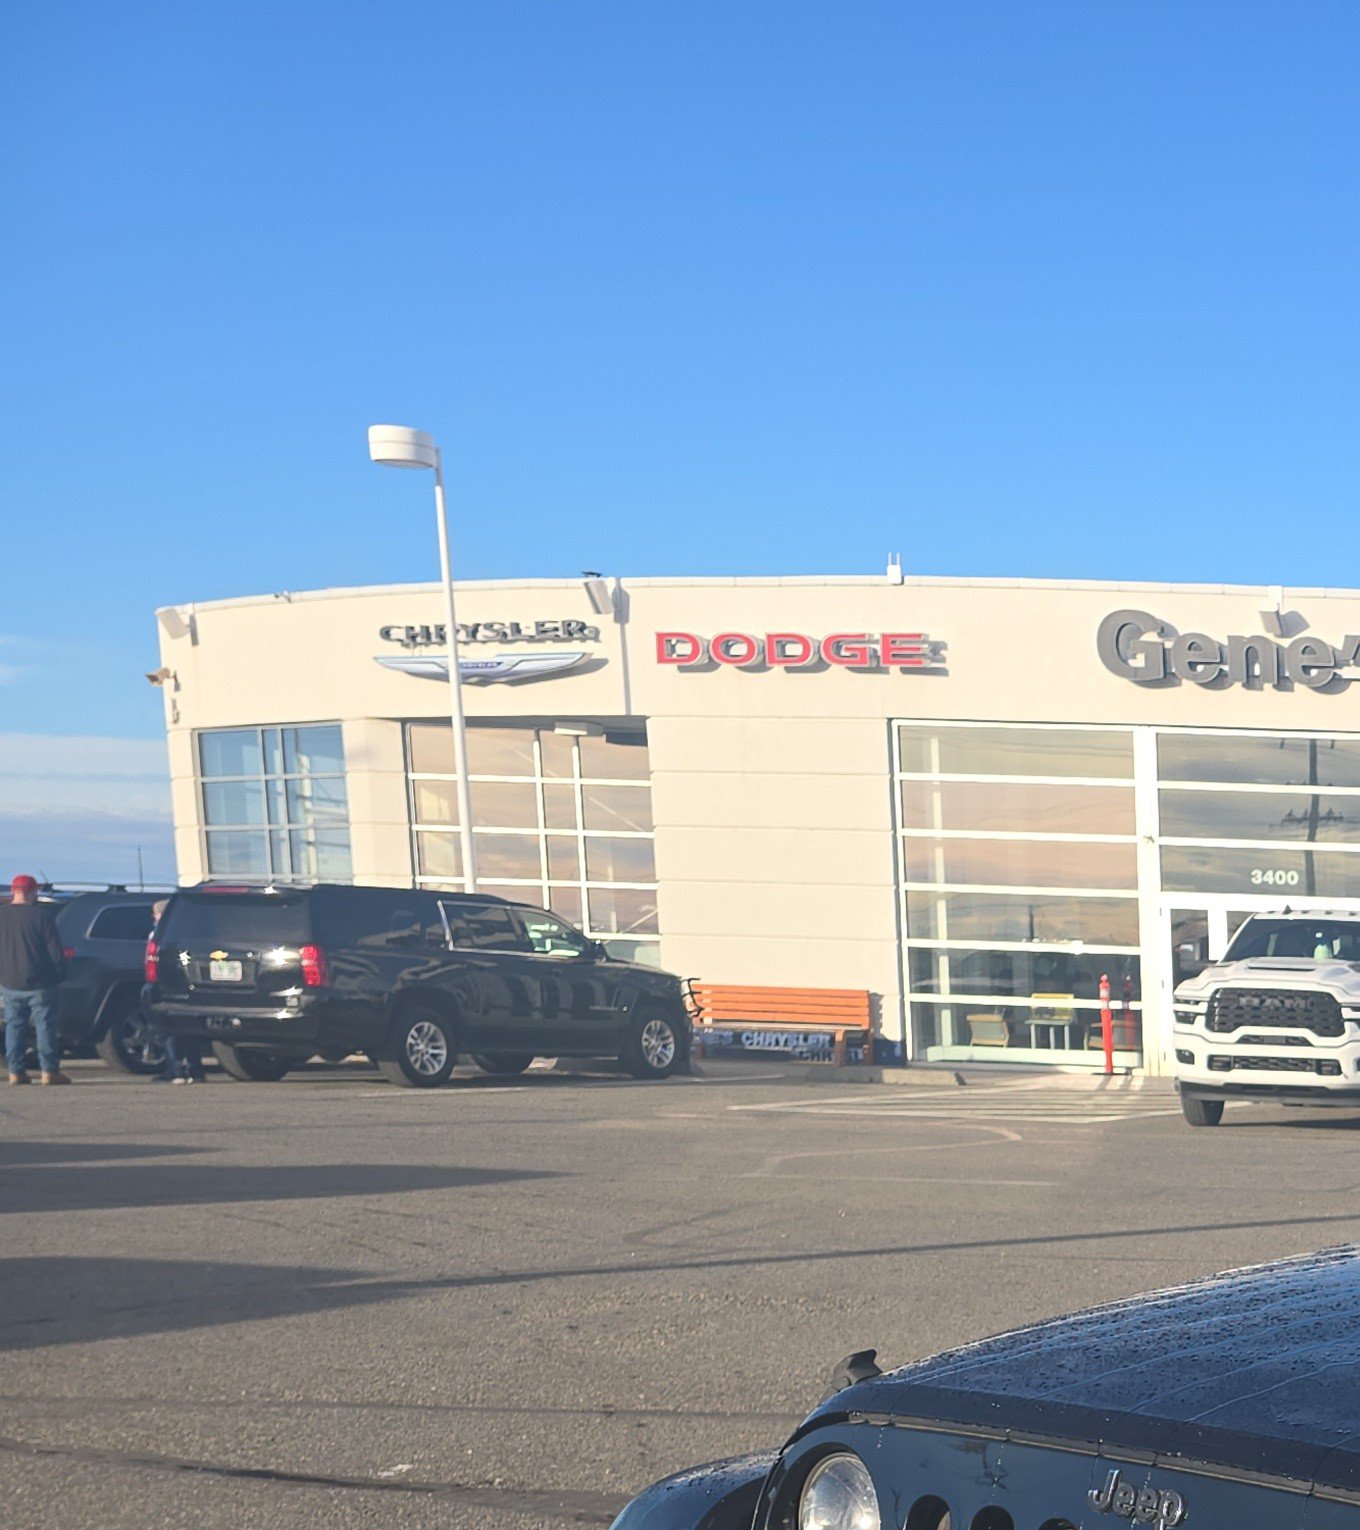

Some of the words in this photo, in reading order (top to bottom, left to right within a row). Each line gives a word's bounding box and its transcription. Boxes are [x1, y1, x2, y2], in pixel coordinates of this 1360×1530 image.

[379, 619, 592, 645] CHRYSLER
[655, 632, 931, 667] DODGE
[1250, 868, 1300, 887] 3400
[1238, 996, 1307, 1010] RAM
